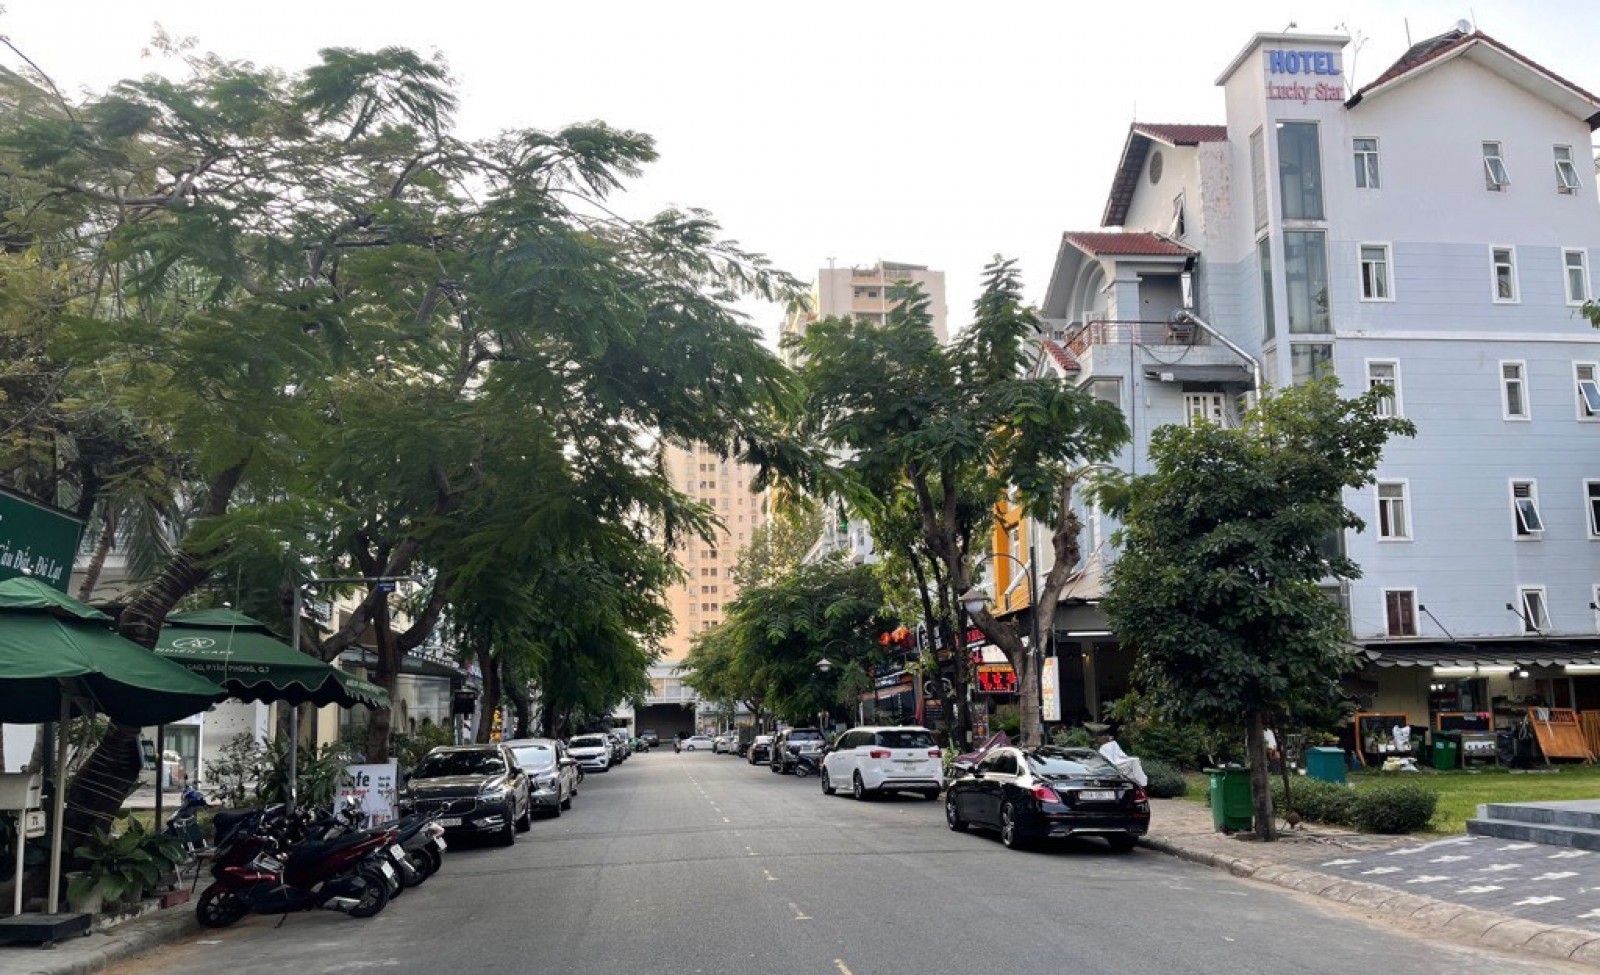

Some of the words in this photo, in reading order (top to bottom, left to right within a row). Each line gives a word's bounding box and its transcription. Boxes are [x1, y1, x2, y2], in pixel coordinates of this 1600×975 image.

[1270, 50, 1340, 75] HOTEL
[1269, 81, 1310, 105] Lucky
[1315, 81, 1345, 101] Star
